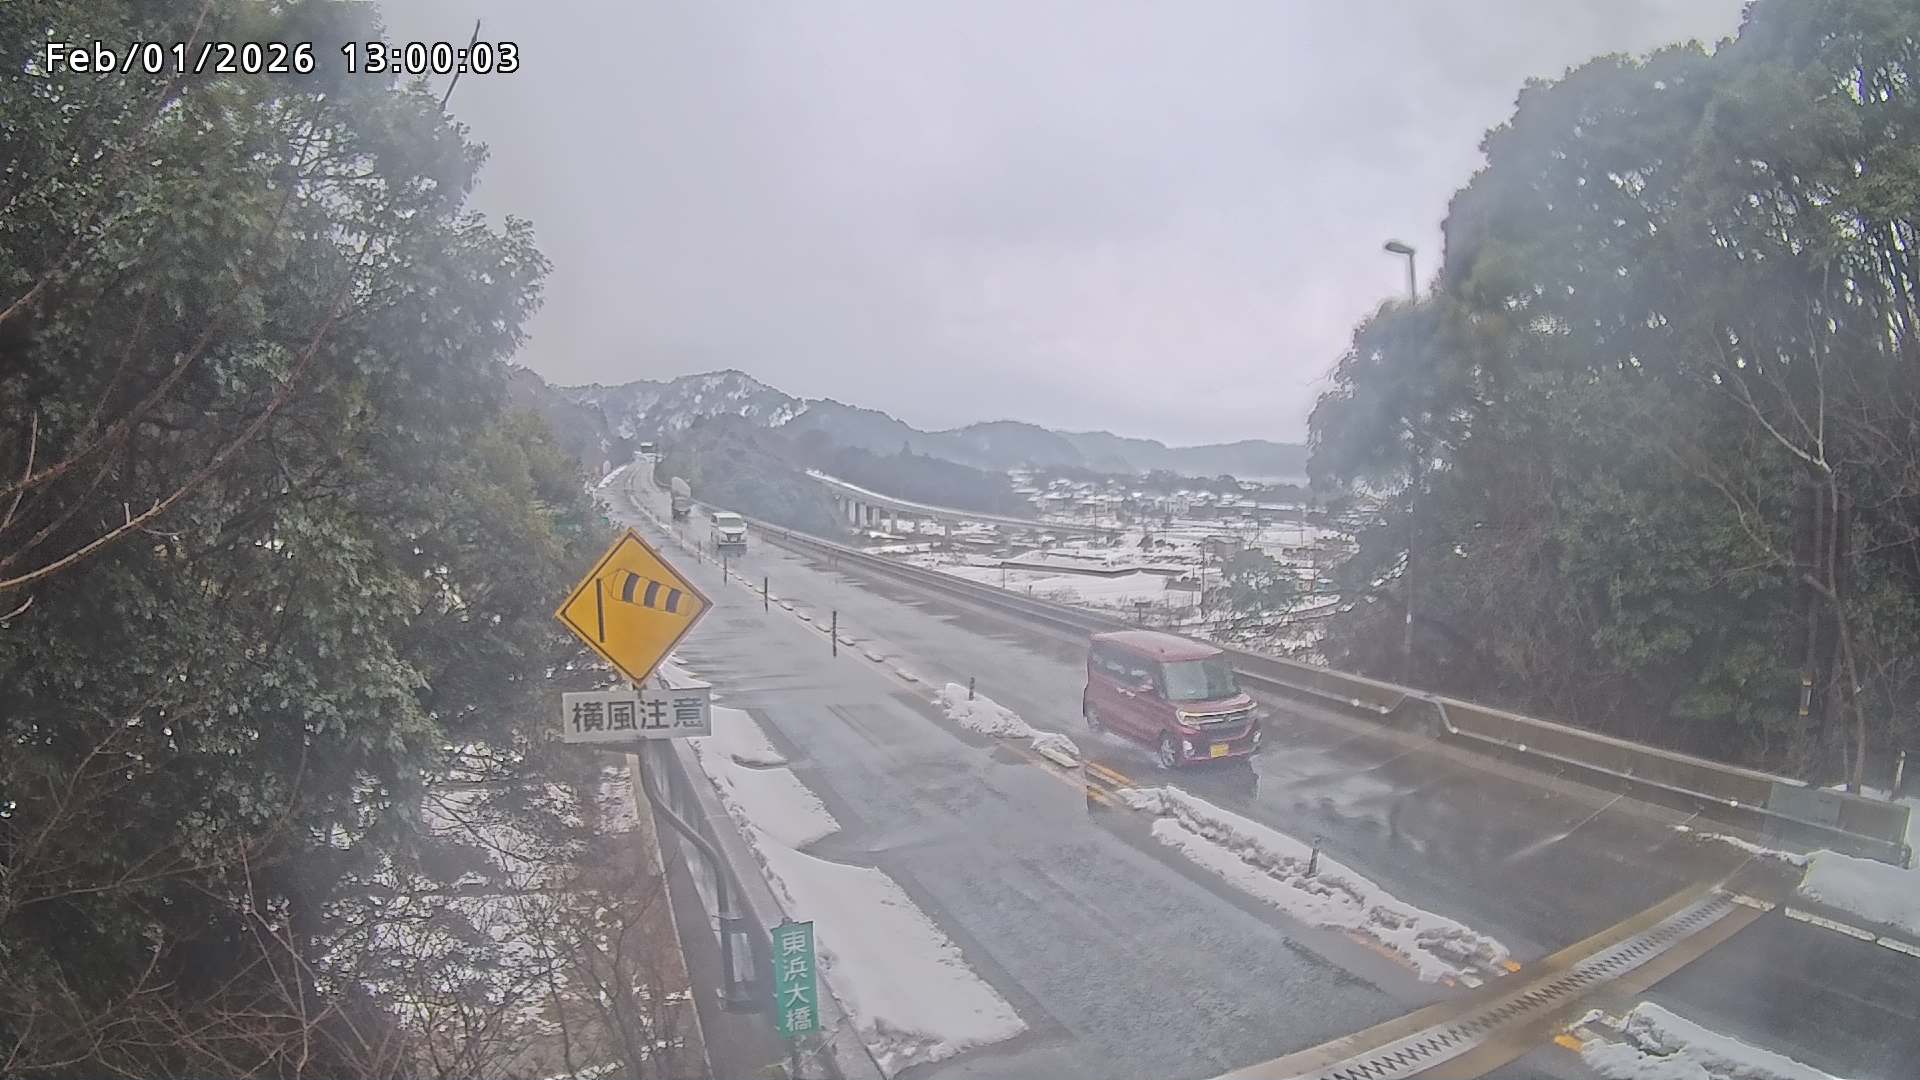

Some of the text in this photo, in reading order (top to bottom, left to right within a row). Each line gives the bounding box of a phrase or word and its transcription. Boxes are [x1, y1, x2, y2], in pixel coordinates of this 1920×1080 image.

[573, 698, 704, 733] 横風注意
[782, 930, 812, 1032] 東浜大橋
